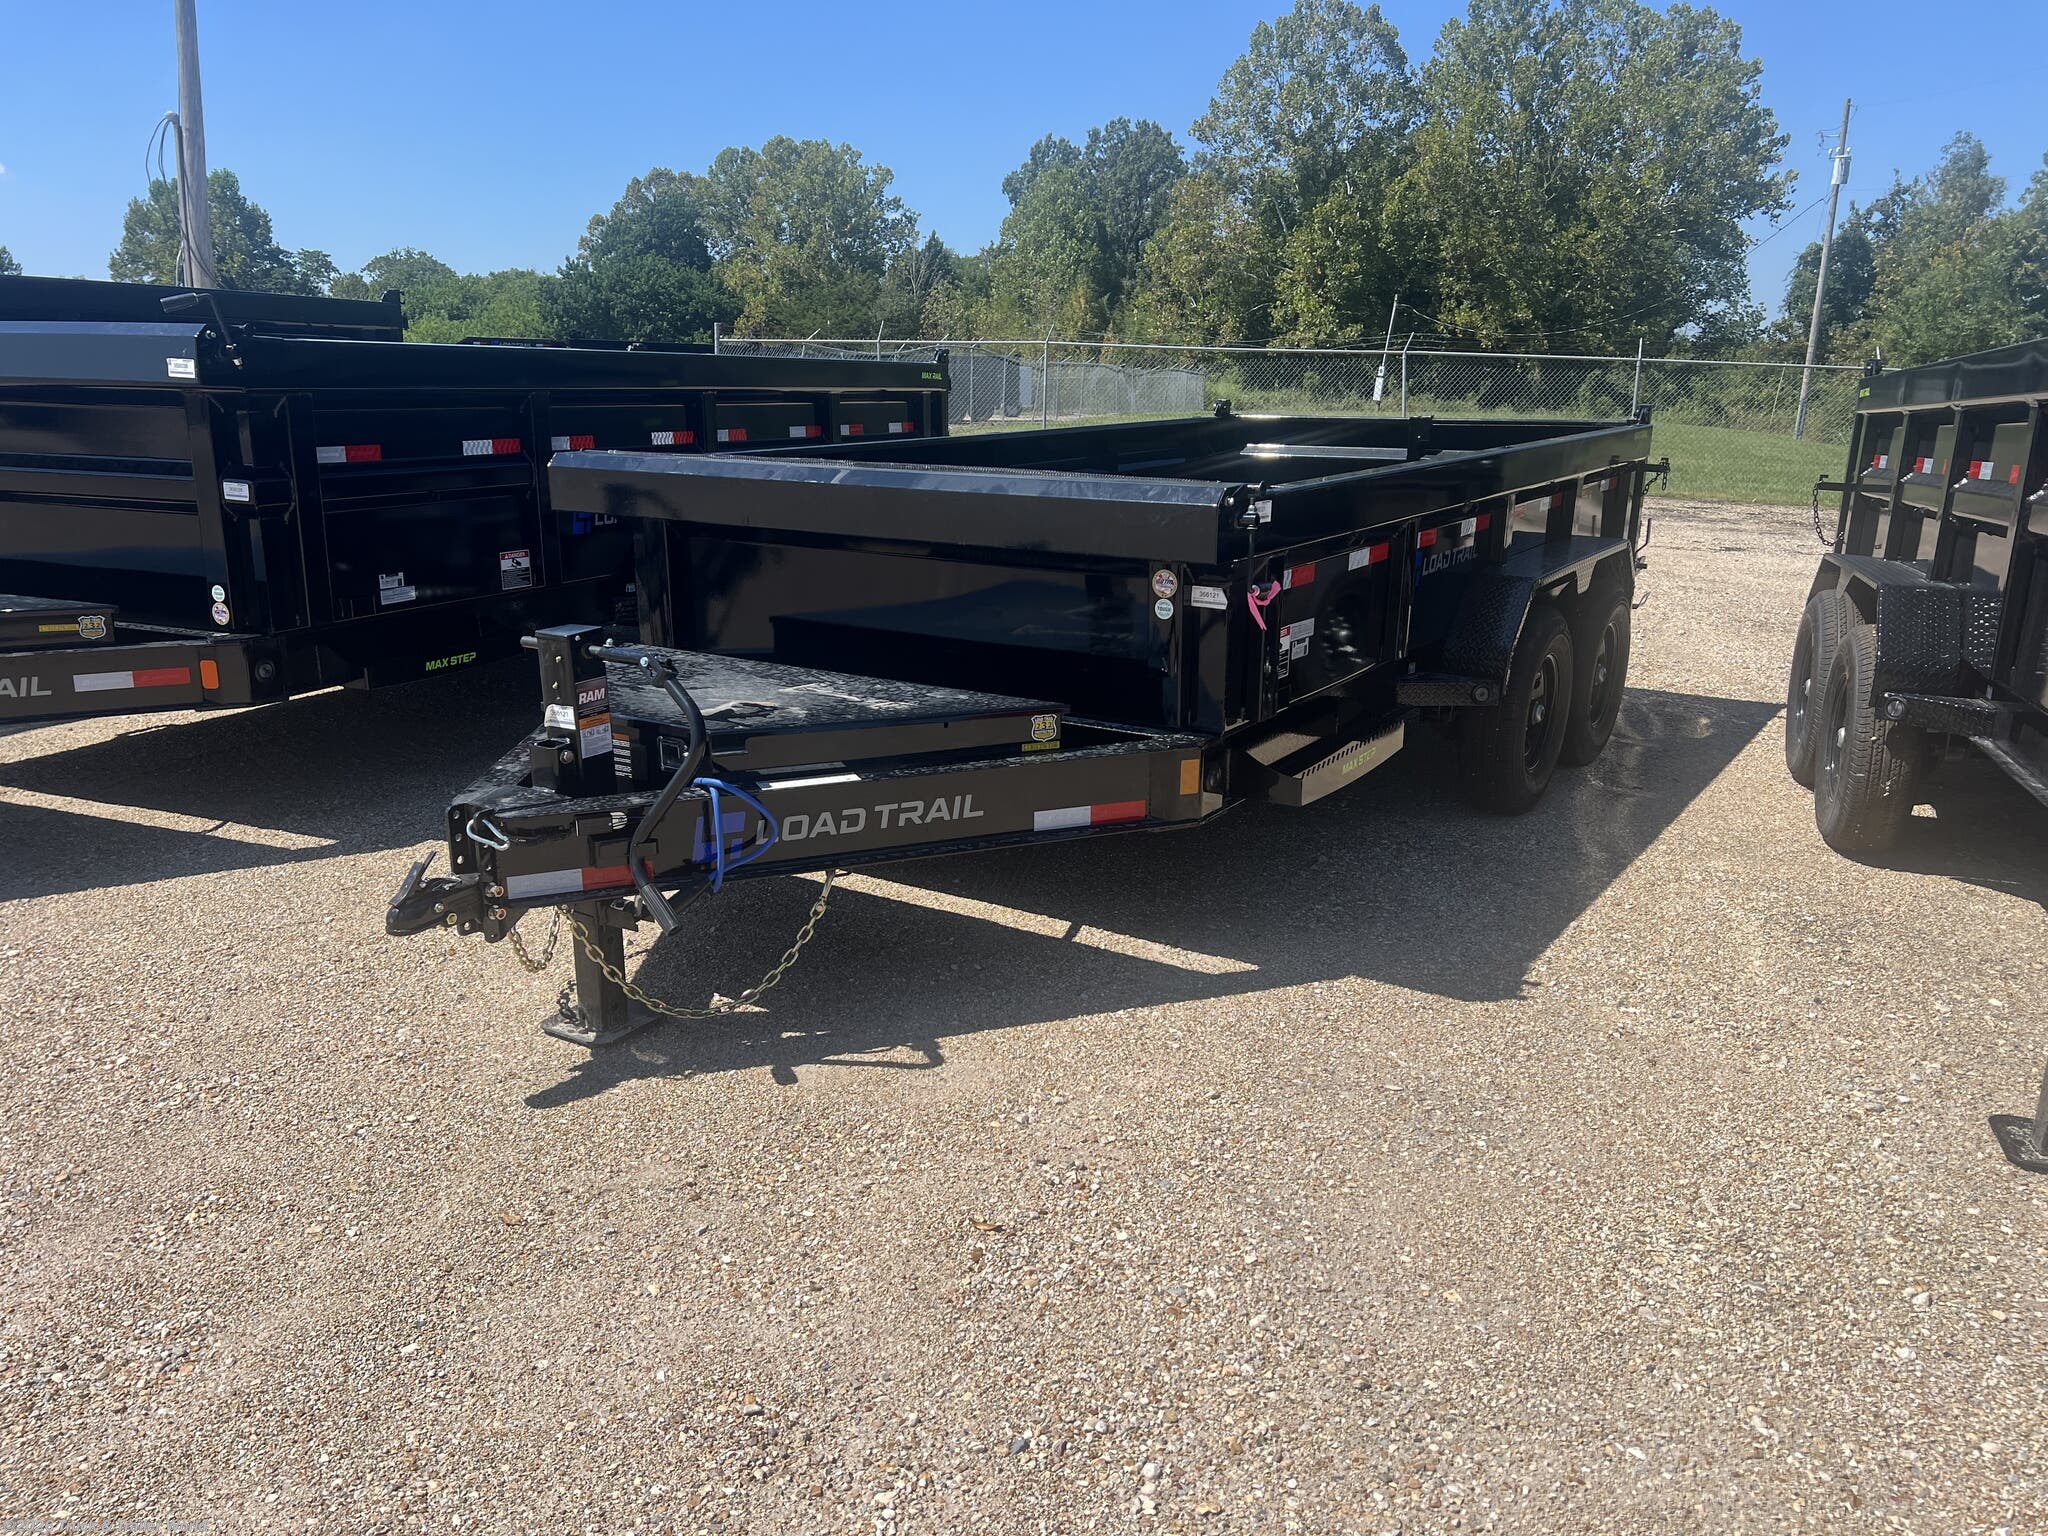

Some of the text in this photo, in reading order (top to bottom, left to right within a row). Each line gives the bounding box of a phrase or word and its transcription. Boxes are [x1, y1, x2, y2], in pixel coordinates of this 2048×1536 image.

[1422, 549, 1451, 576] LOAD
[425, 652, 477, 671] MAX STEP
[579, 688, 605, 705] RAM
[755, 794, 984, 846] LOAD TRAIL
